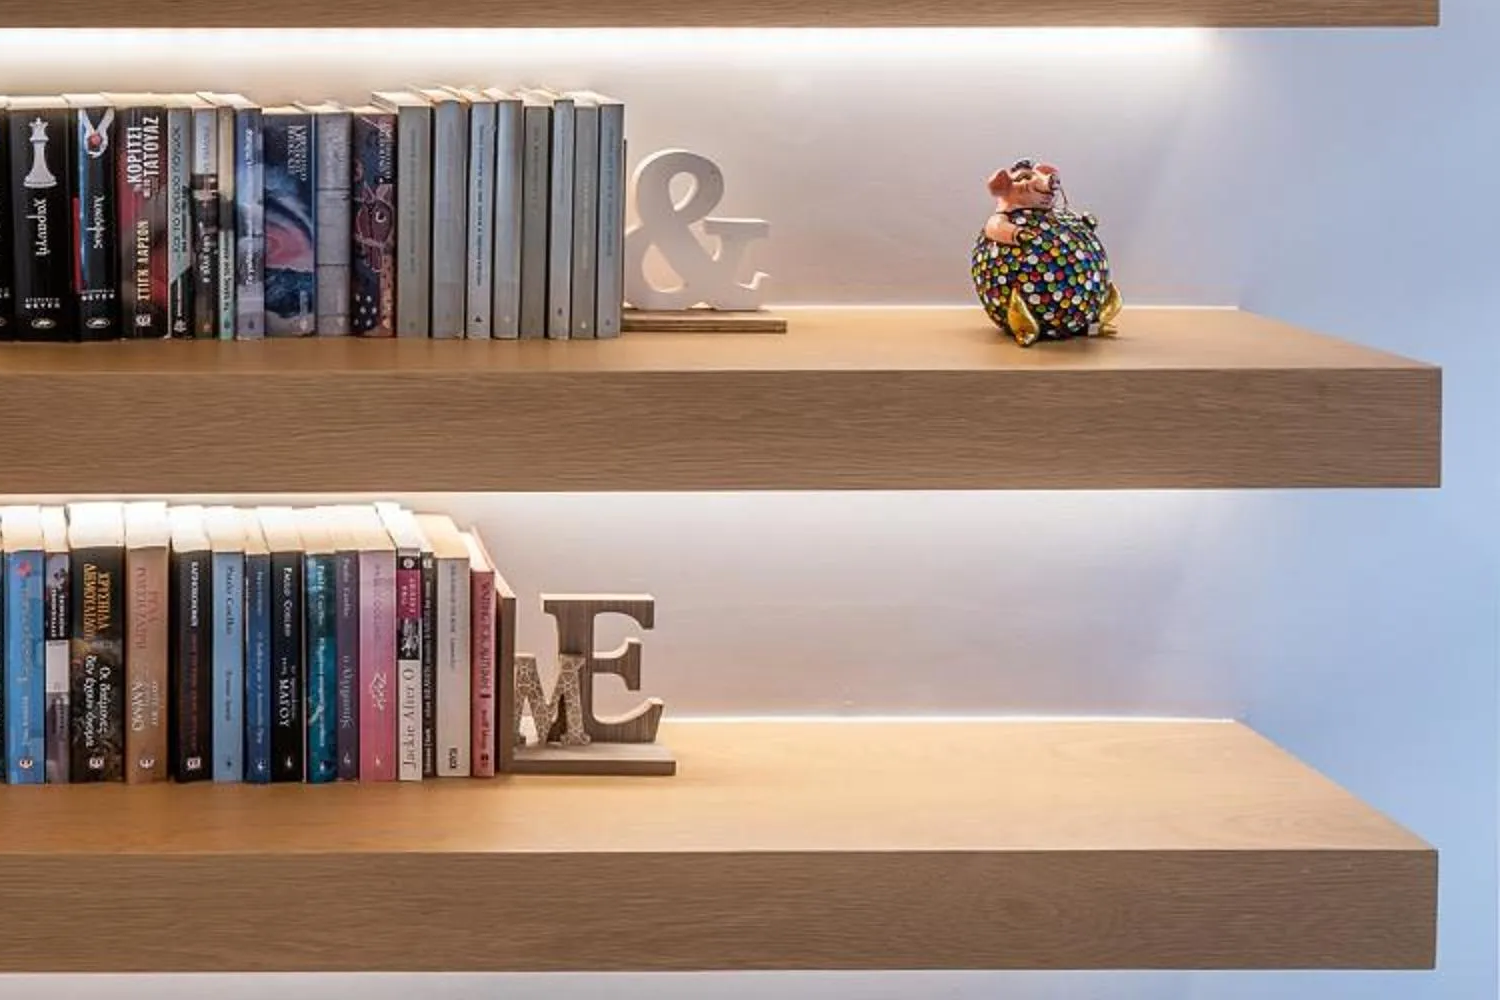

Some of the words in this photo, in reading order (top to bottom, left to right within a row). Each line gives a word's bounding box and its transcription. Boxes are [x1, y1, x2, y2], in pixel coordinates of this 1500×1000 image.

[127, 126, 143, 184] ΚΟΡΙΤΣΙ
[143, 115, 160, 178] ΤΑΤΟΥΑΖ
[25, 197, 51, 257] χαραυγή
[625, 149, 770, 311] &
[226, 565, 236, 595] Paulo
[225, 598, 235, 635] Coelho
[401, 668, 414, 682] O
[403, 725, 418, 769] Jackie
